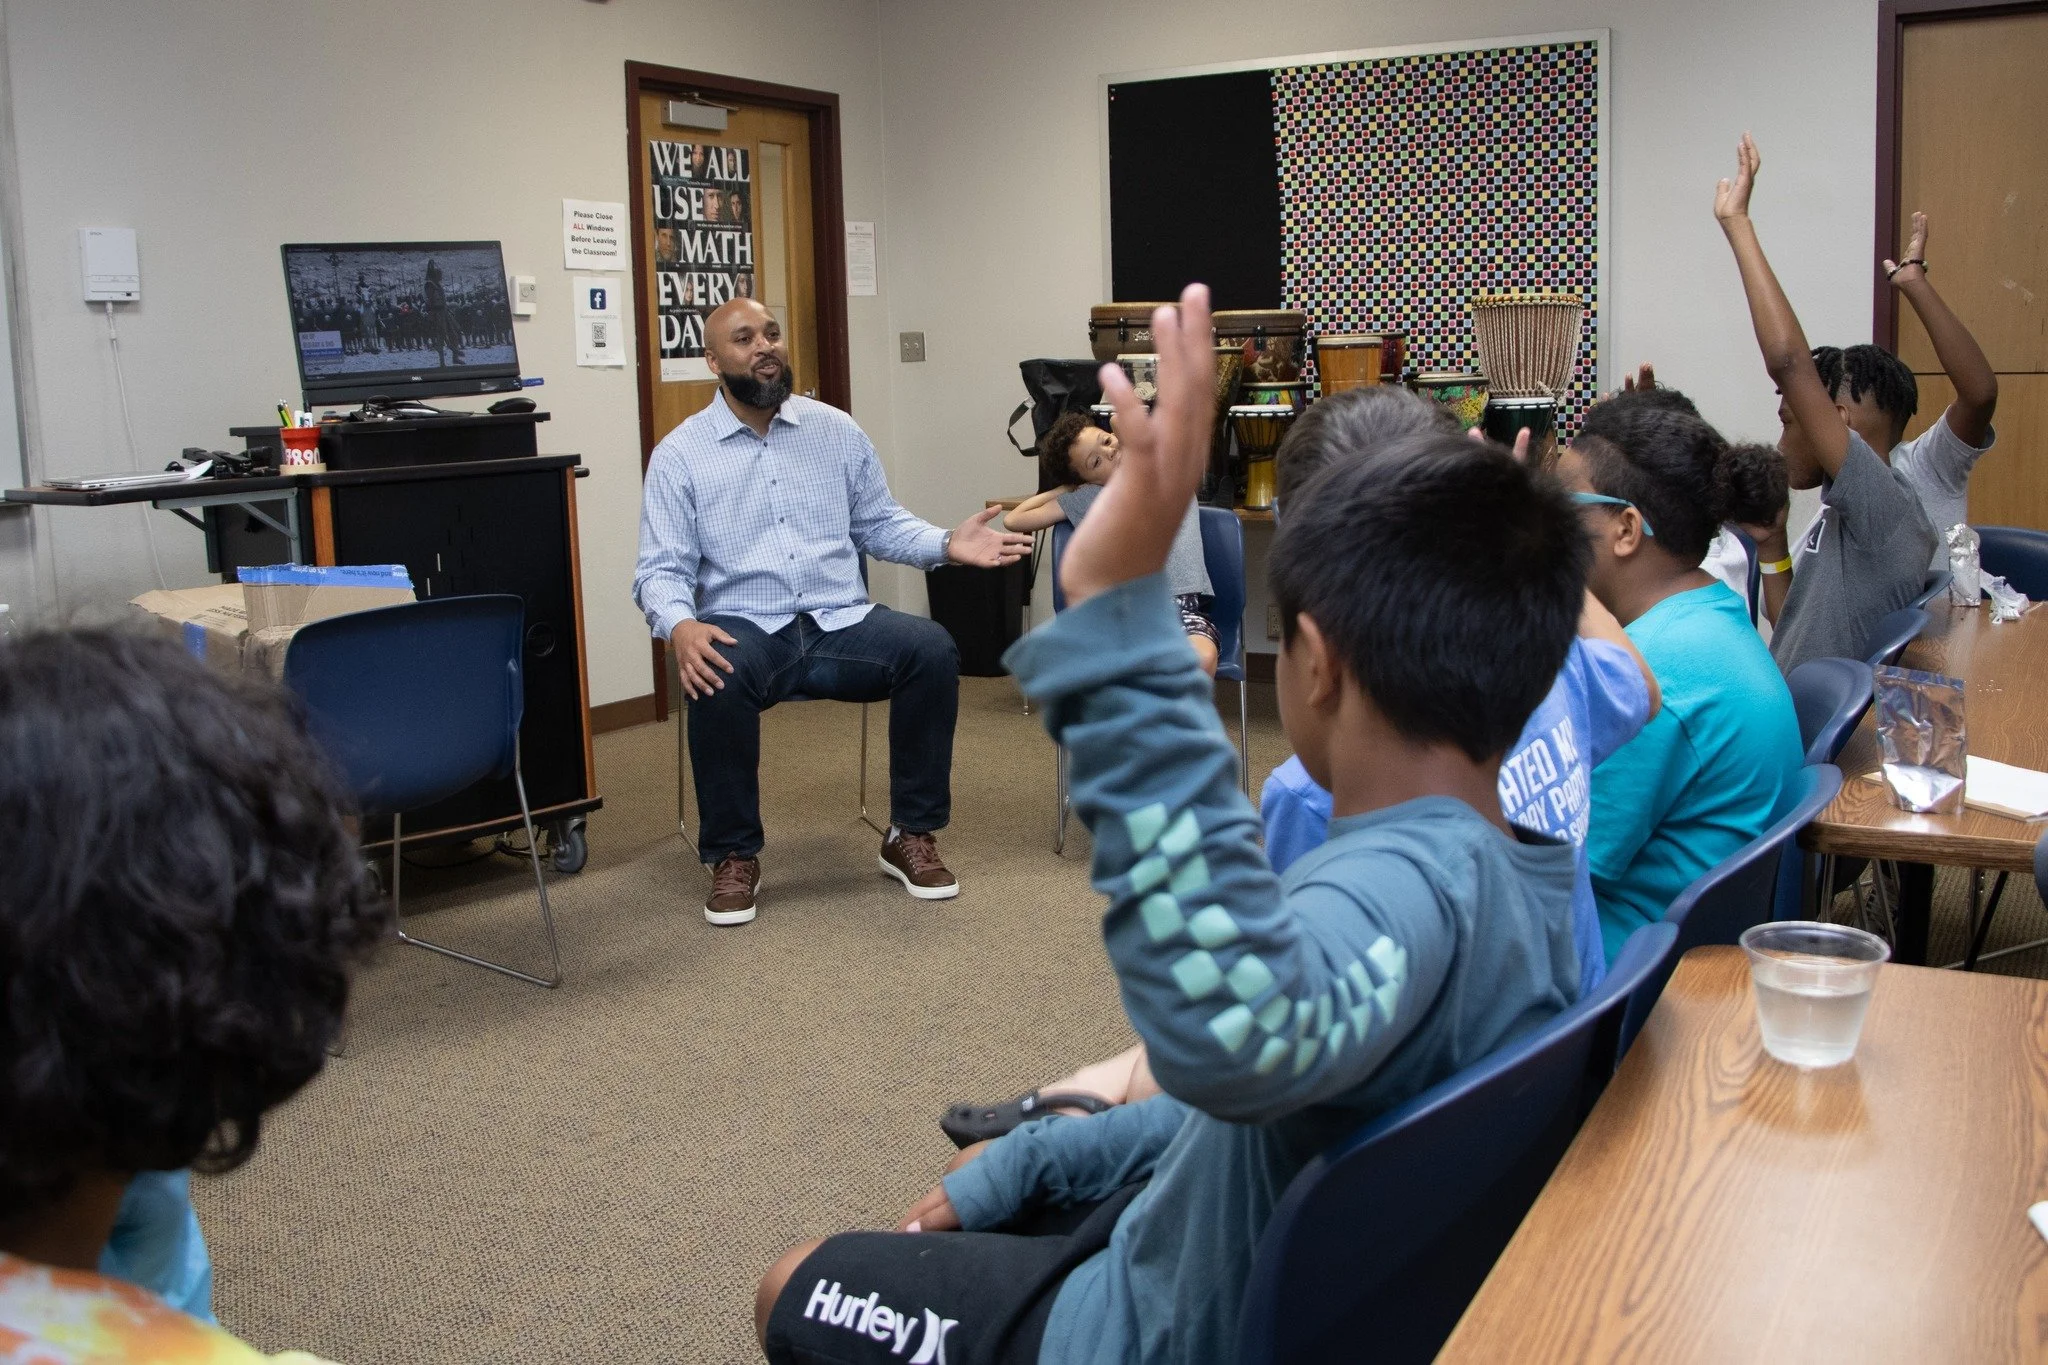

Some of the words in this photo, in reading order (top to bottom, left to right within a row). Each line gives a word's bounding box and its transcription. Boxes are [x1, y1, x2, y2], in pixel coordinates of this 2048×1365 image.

[650, 140, 693, 178] WE
[706, 147, 750, 182] ALL
[573, 210, 594, 219] Please
[595, 212, 613, 220] Close
[652, 184, 704, 221] USE
[571, 235, 591, 243] Before
[592, 237, 617, 246] Leaving
[573, 223, 585, 231] ALL
[586, 224, 614, 232] Windows
[583, 248, 617, 257] Classroom!
[679, 229, 753, 264] MATH
[656, 272, 741, 306] EVERY
[658, 314, 706, 349] DAY
[804, 1278, 919, 1354] Hurley
